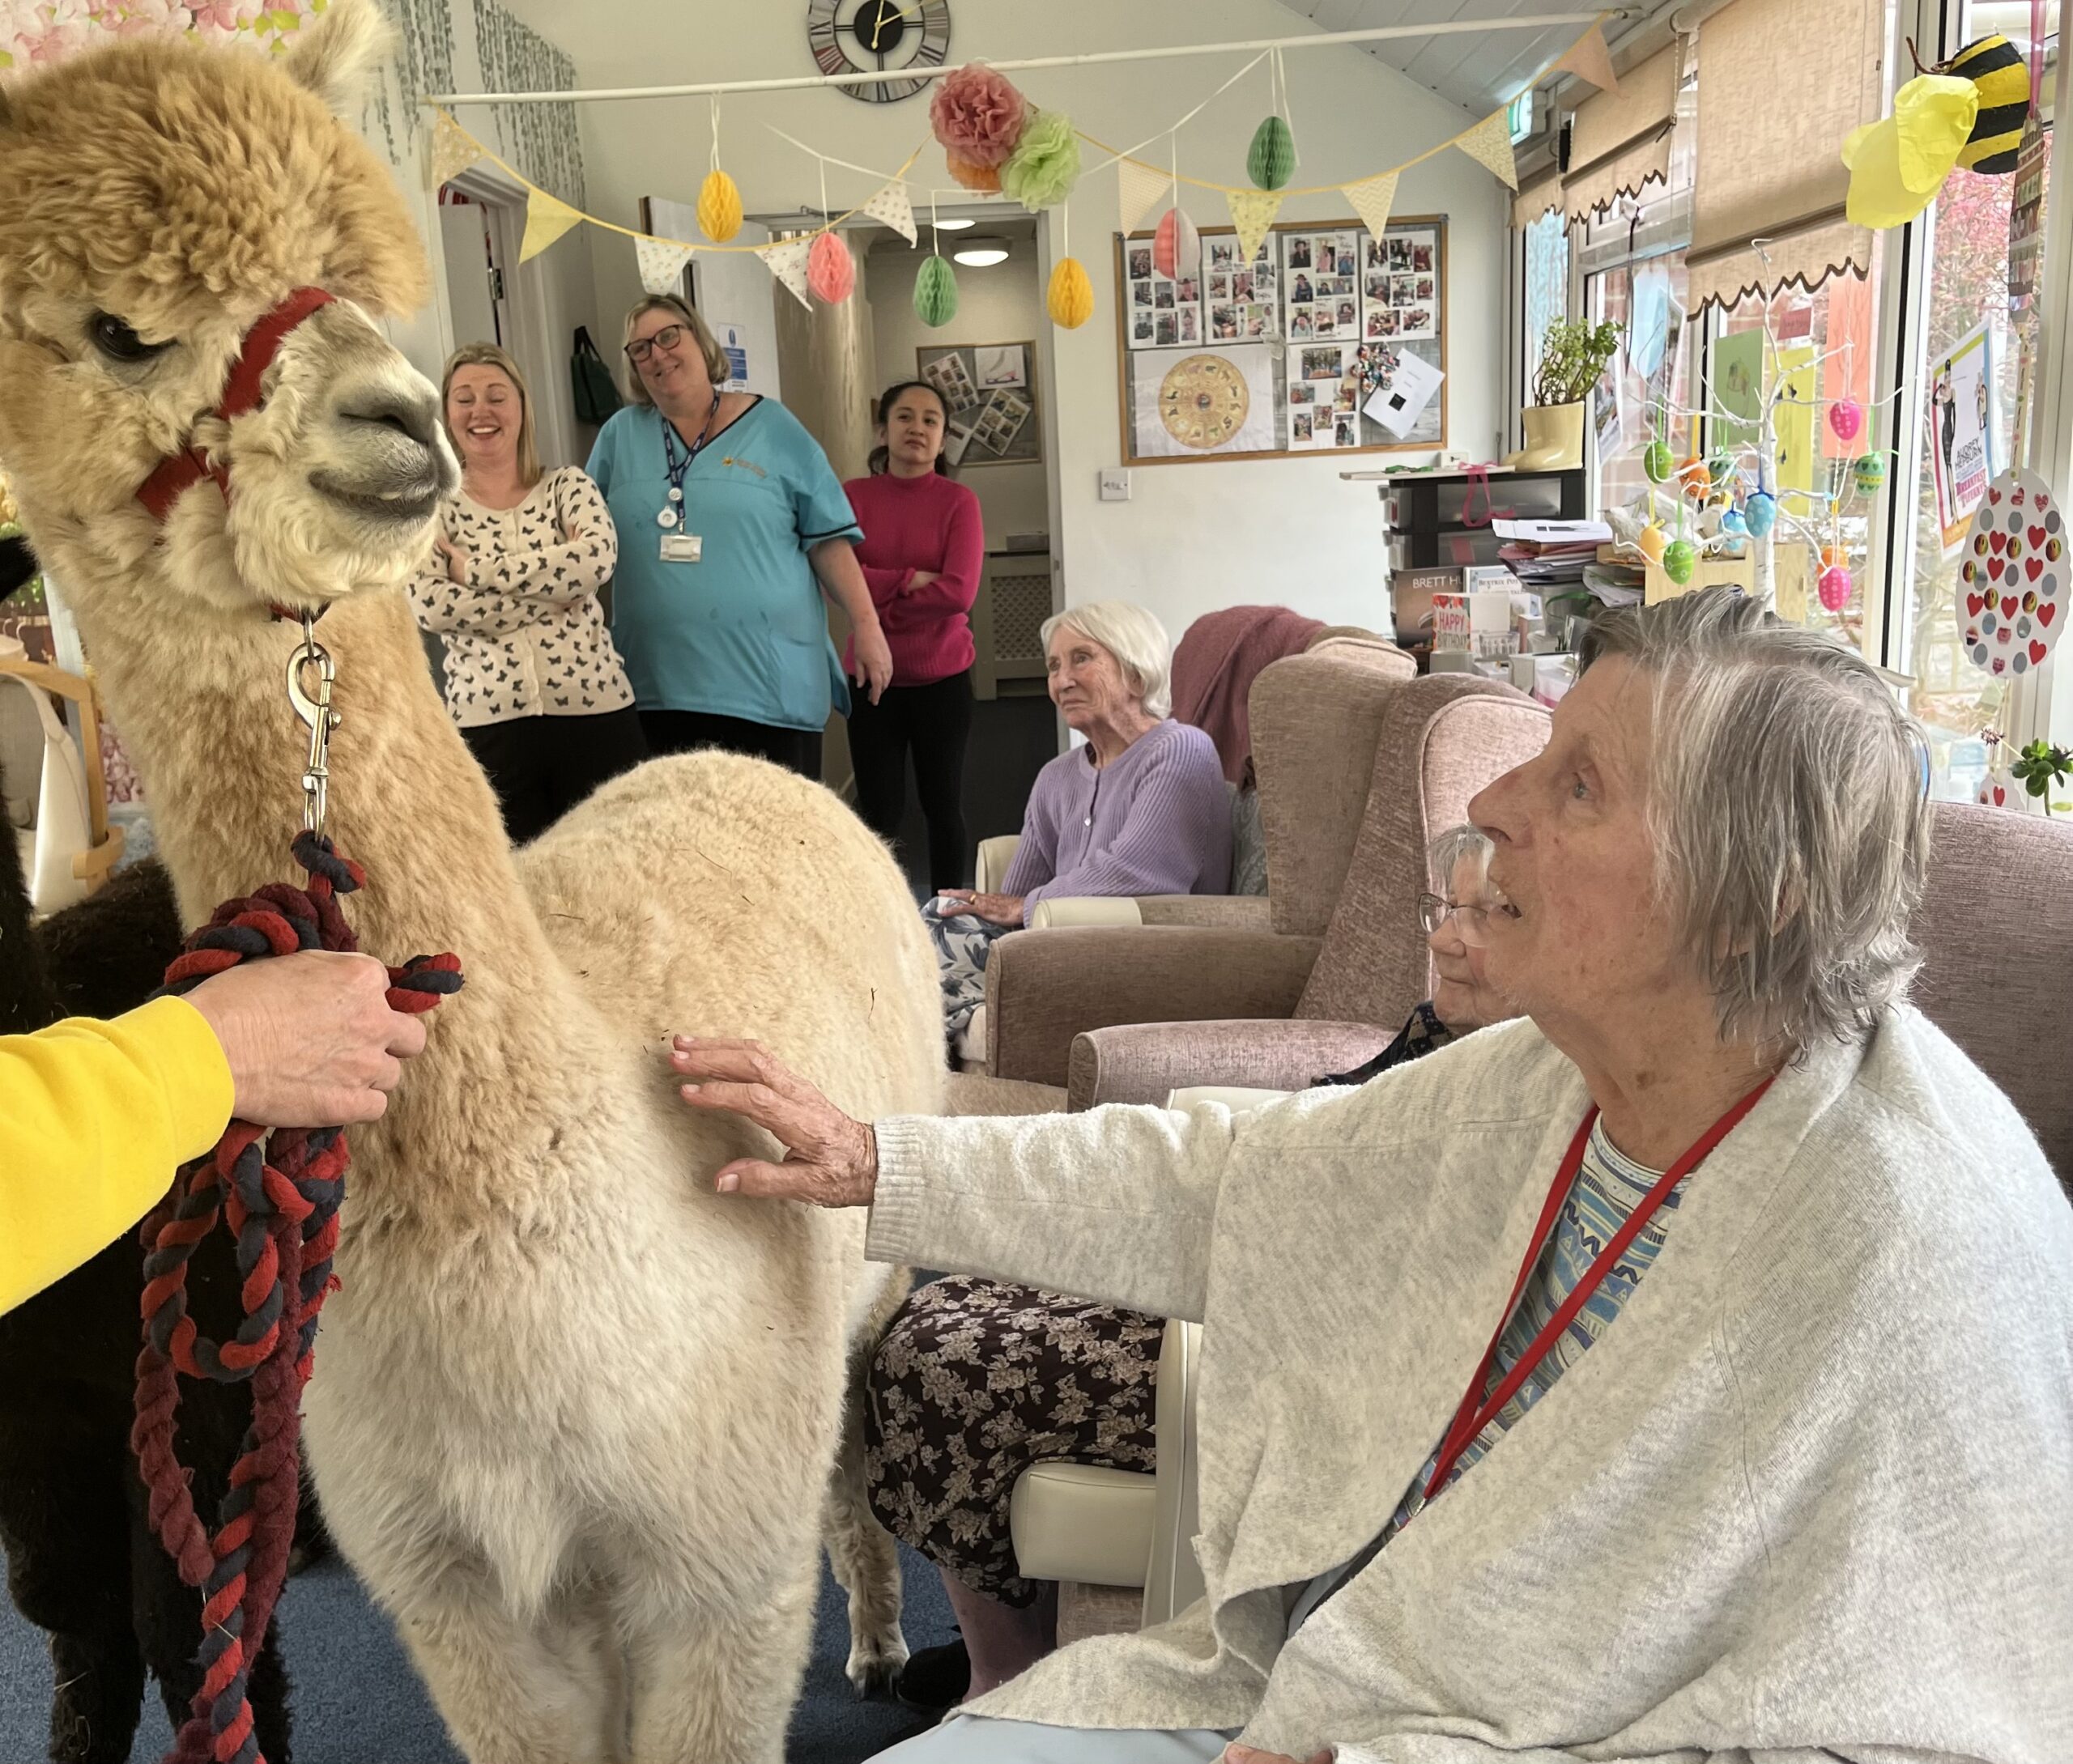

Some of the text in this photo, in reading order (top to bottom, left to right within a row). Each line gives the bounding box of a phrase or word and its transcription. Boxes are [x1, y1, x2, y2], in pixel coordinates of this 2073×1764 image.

[1412, 576, 1445, 589] BRETT
[1438, 611, 1466, 632] HAPPY
[1437, 630, 1467, 648] BIRTHDAY
